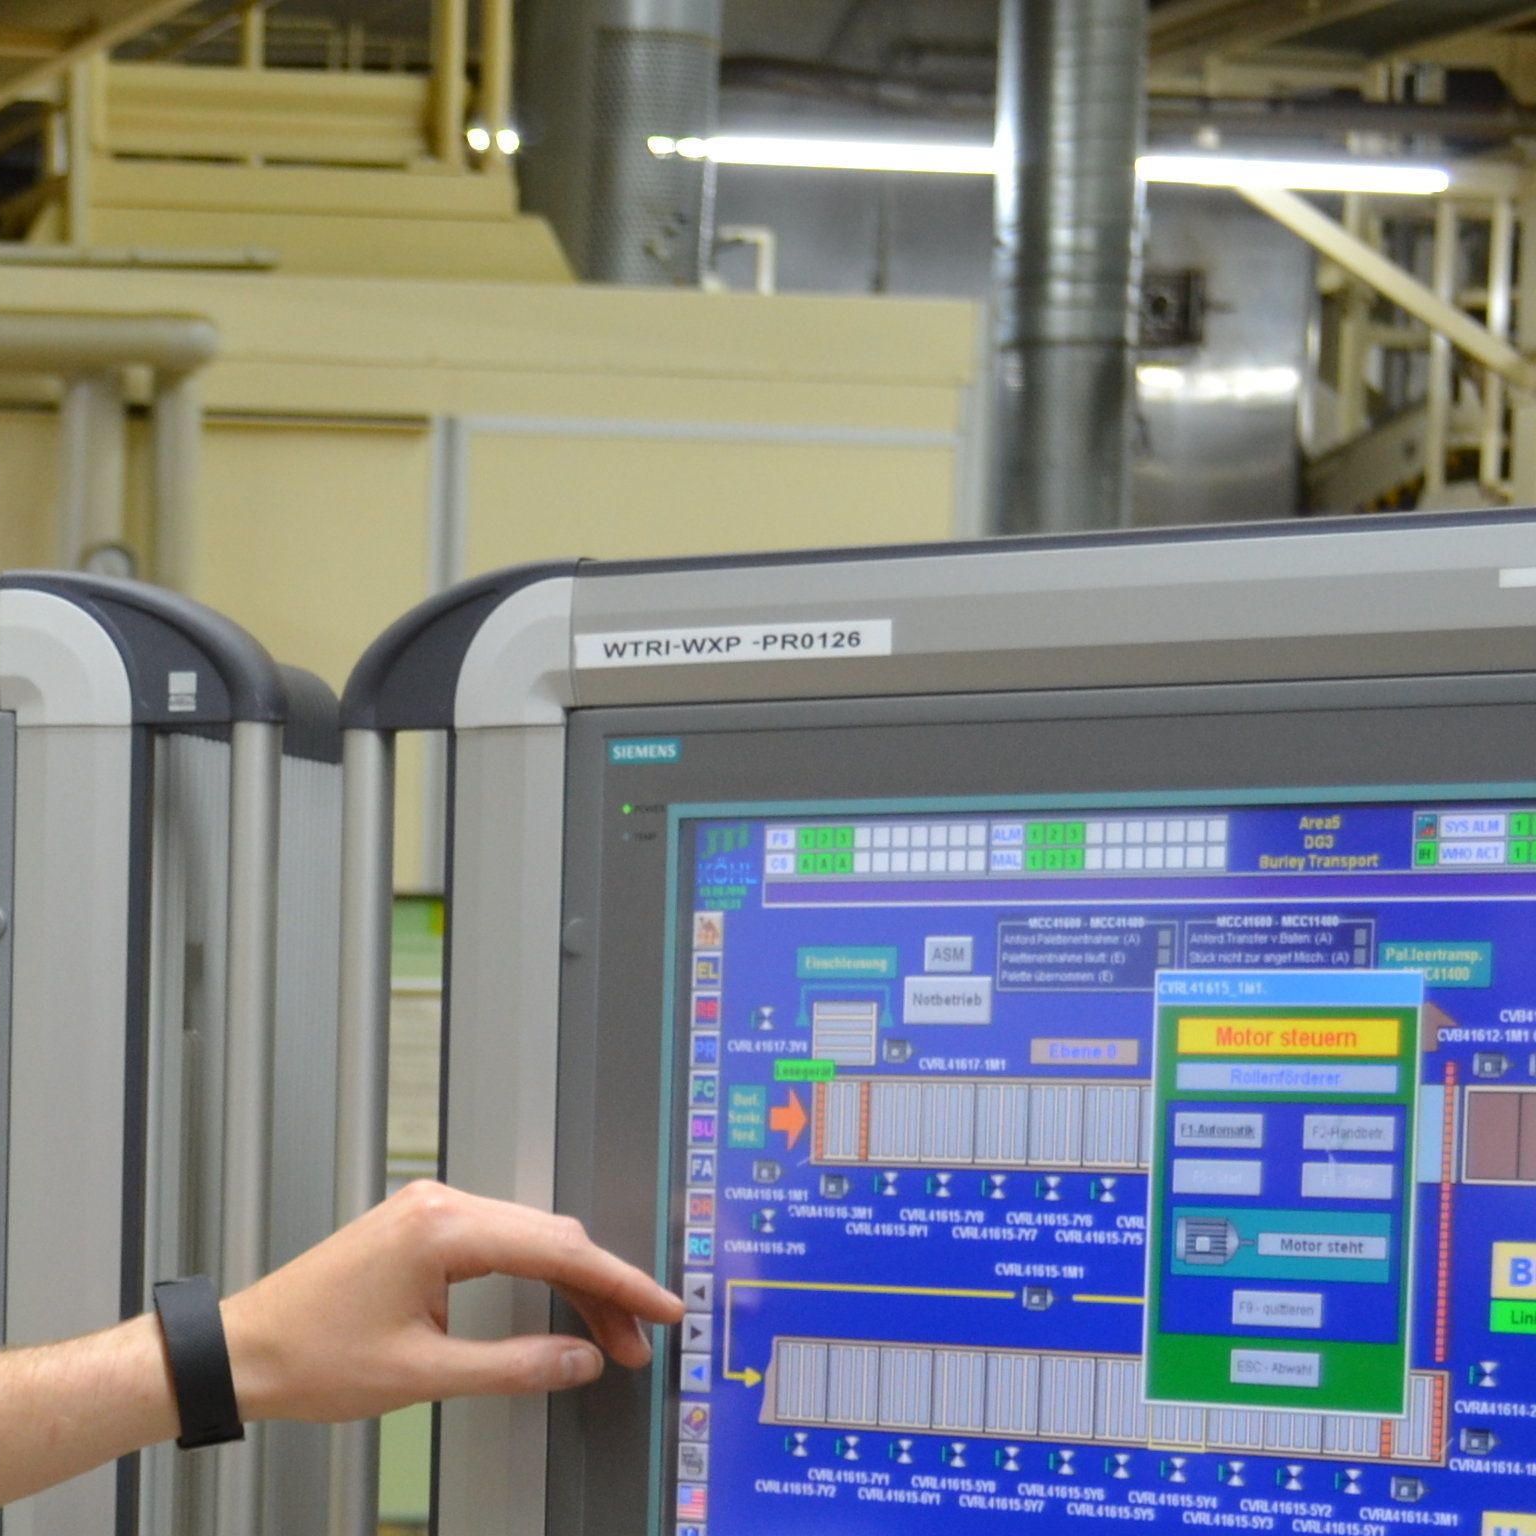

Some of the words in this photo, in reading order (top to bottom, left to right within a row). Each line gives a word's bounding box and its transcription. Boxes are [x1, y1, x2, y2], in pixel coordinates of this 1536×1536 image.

[603, 635, 741, 658] WTRI-WXP
[752, 631, 862, 652] -PR0126
[612, 743, 676, 760] SIEMENS
[1445, 819, 1468, 832] SYS
[1473, 819, 1499, 832] ALM
[1309, 854, 1379, 869] Transport
[932, 948, 964, 962] ASM
[913, 993, 982, 1006] Notbetrieb
[1216, 1027, 1273, 1047] Motor
[1280, 1030, 1357, 1047] steuern
[1231, 1068, 1342, 1085] Rollenförderer
[1181, 1123, 1255, 1138] F1-Automatik
[1280, 1238, 1321, 1252] Motor
[1328, 1241, 1363, 1254] steht
[1272, 1362, 1312, 1375] Abwahl
